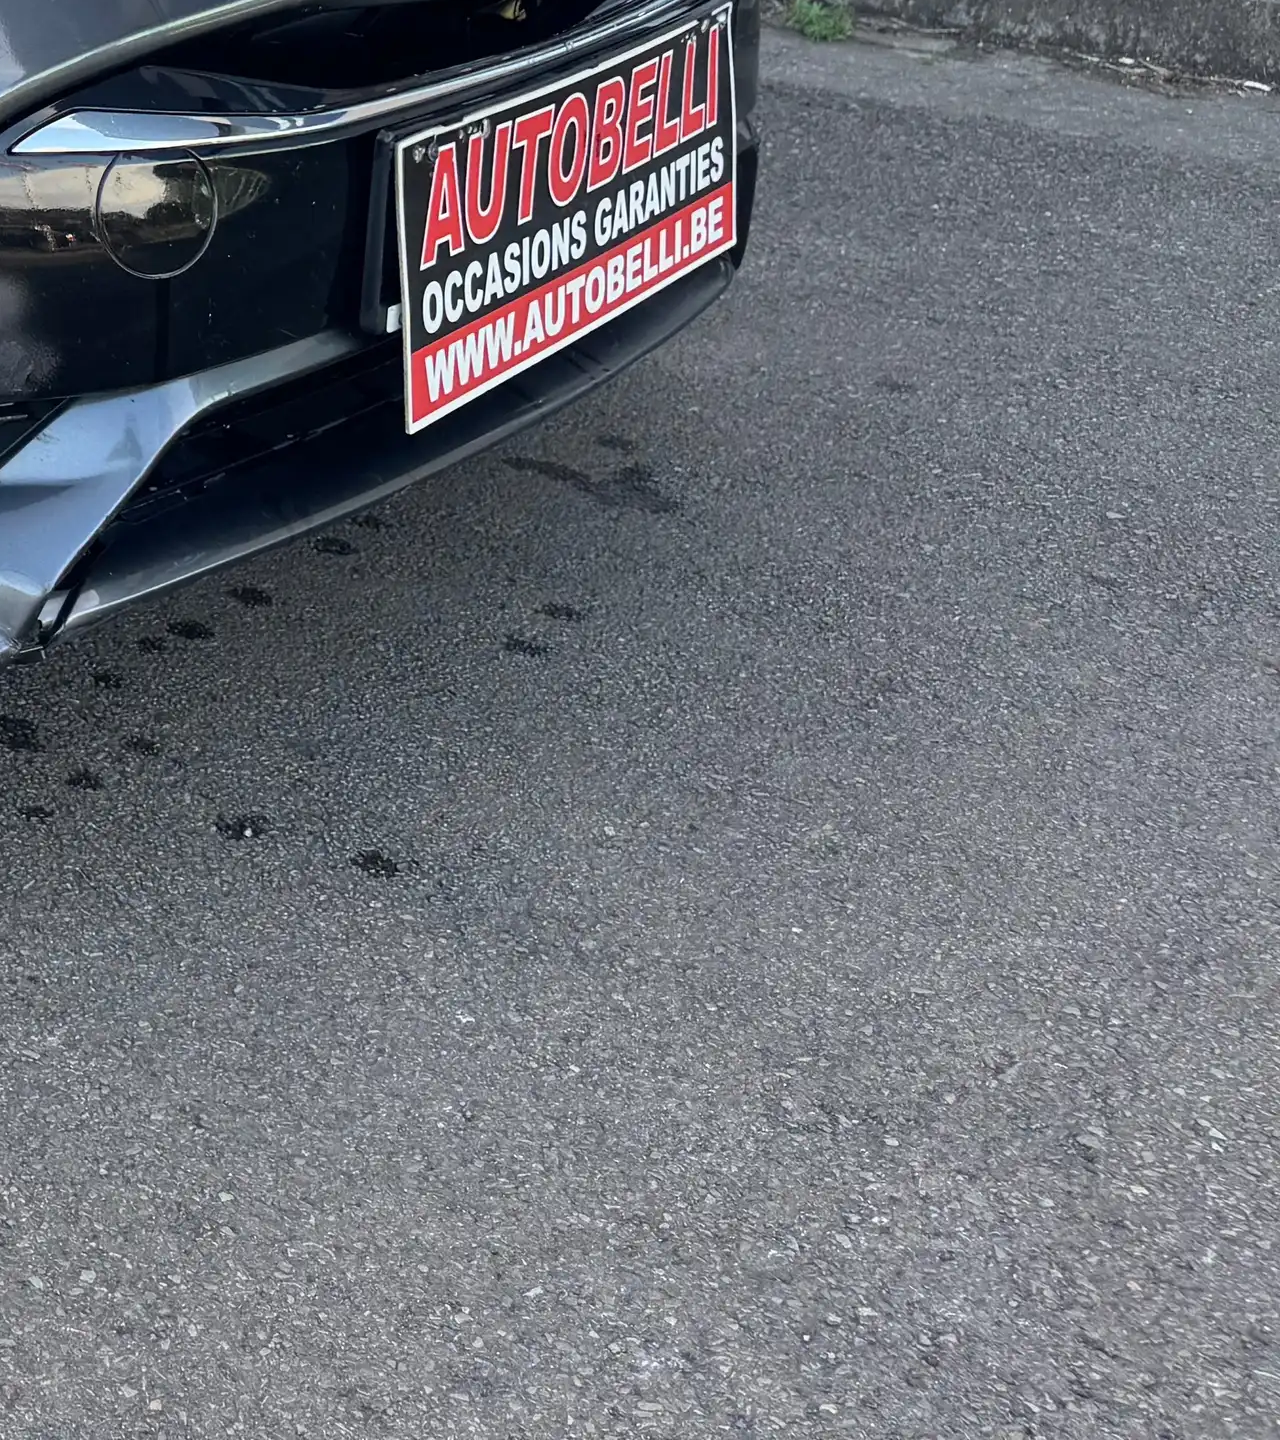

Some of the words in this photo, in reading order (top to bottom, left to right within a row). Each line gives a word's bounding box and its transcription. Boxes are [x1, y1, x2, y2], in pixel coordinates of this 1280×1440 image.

[420, 24, 720, 272] AUTOBELLI
[422, 210, 587, 335] OCCASIONS
[594, 135, 724, 248] GARANTIES
[424, 195, 724, 403] WWW.AUTOBELLI.BE
